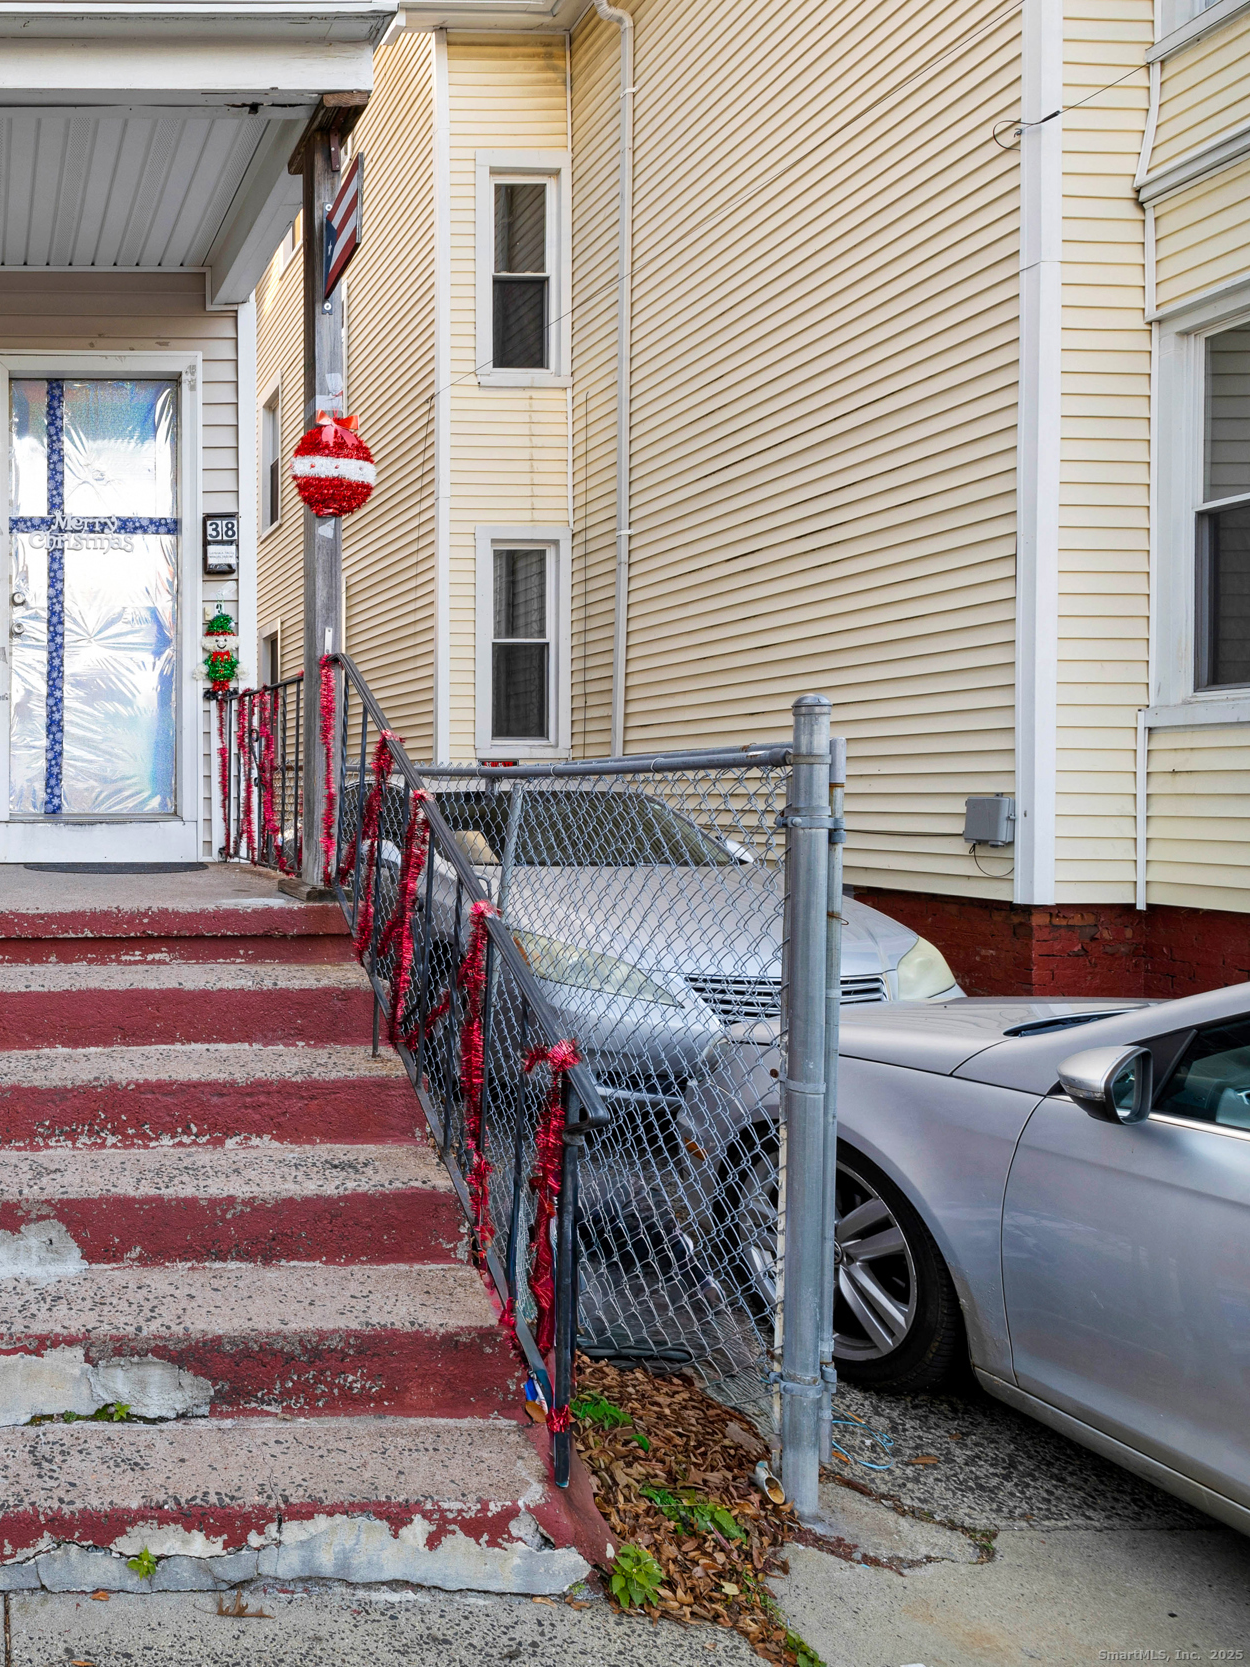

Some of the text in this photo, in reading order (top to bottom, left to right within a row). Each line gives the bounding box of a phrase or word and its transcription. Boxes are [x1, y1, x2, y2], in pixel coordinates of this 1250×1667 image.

[50, 510, 117, 535] Merry
[208, 521, 236, 538] 38
[28, 529, 135, 555] Christmas
